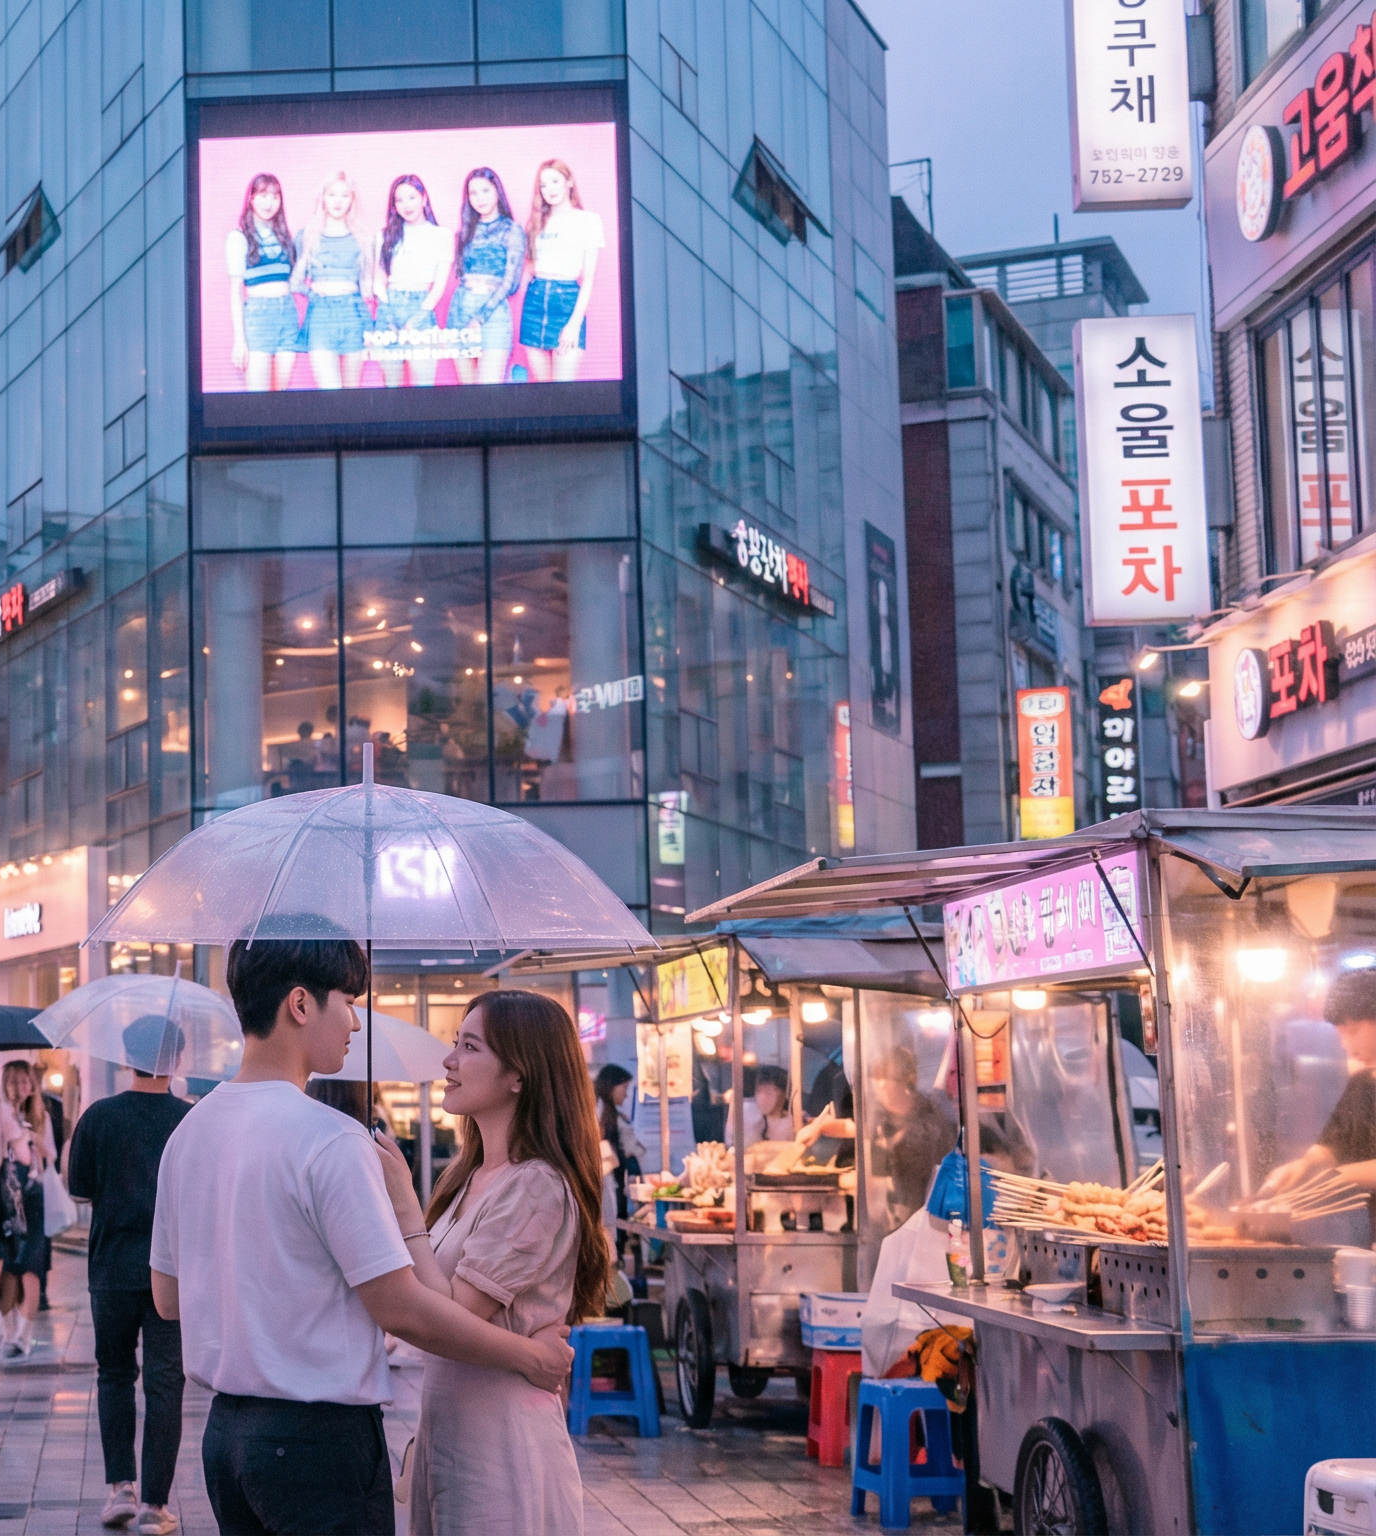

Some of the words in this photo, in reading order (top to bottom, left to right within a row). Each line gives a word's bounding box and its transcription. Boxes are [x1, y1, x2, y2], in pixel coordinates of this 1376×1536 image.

[1107, 0, 1156, 124] 쿠채
[1090, 166, 1184, 185] 752-2729
[1268, 620, 1329, 719] 포차
